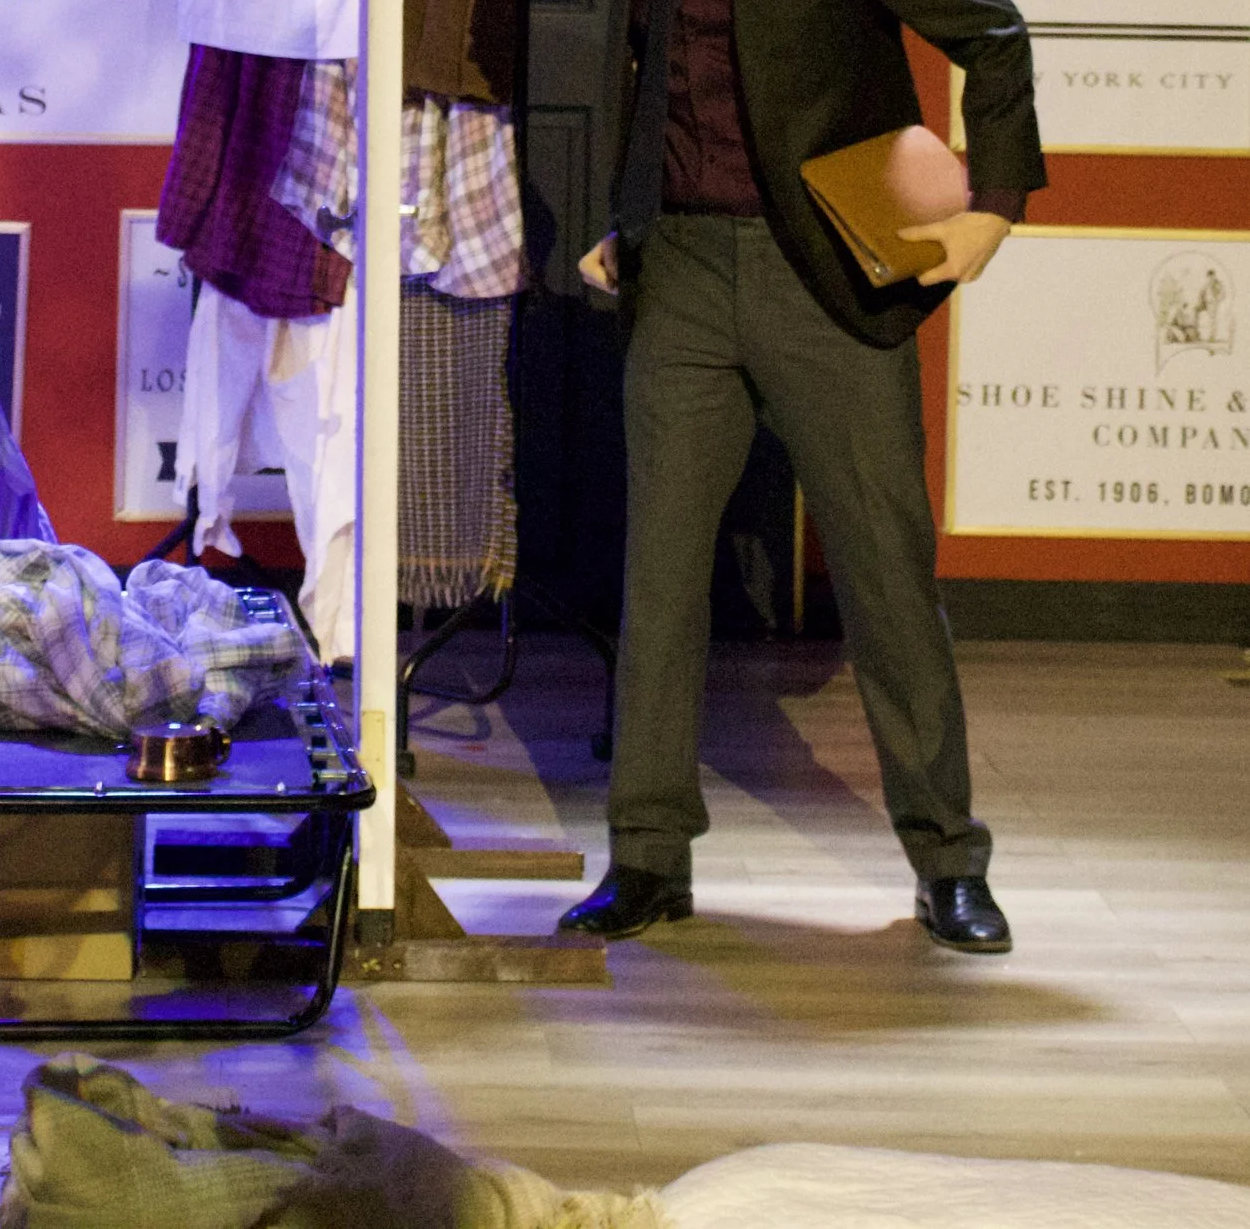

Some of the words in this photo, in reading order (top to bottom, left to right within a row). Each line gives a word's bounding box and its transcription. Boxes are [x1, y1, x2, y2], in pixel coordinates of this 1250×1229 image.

[1064, 71, 1144, 89] YORK
[1160, 72, 1234, 90] CITY
[956, 383, 1060, 408] SHOE
[1081, 386, 1206, 413] SHINE
[1227, 391, 1248, 413] &
[1028, 478, 1080, 502] EST.
